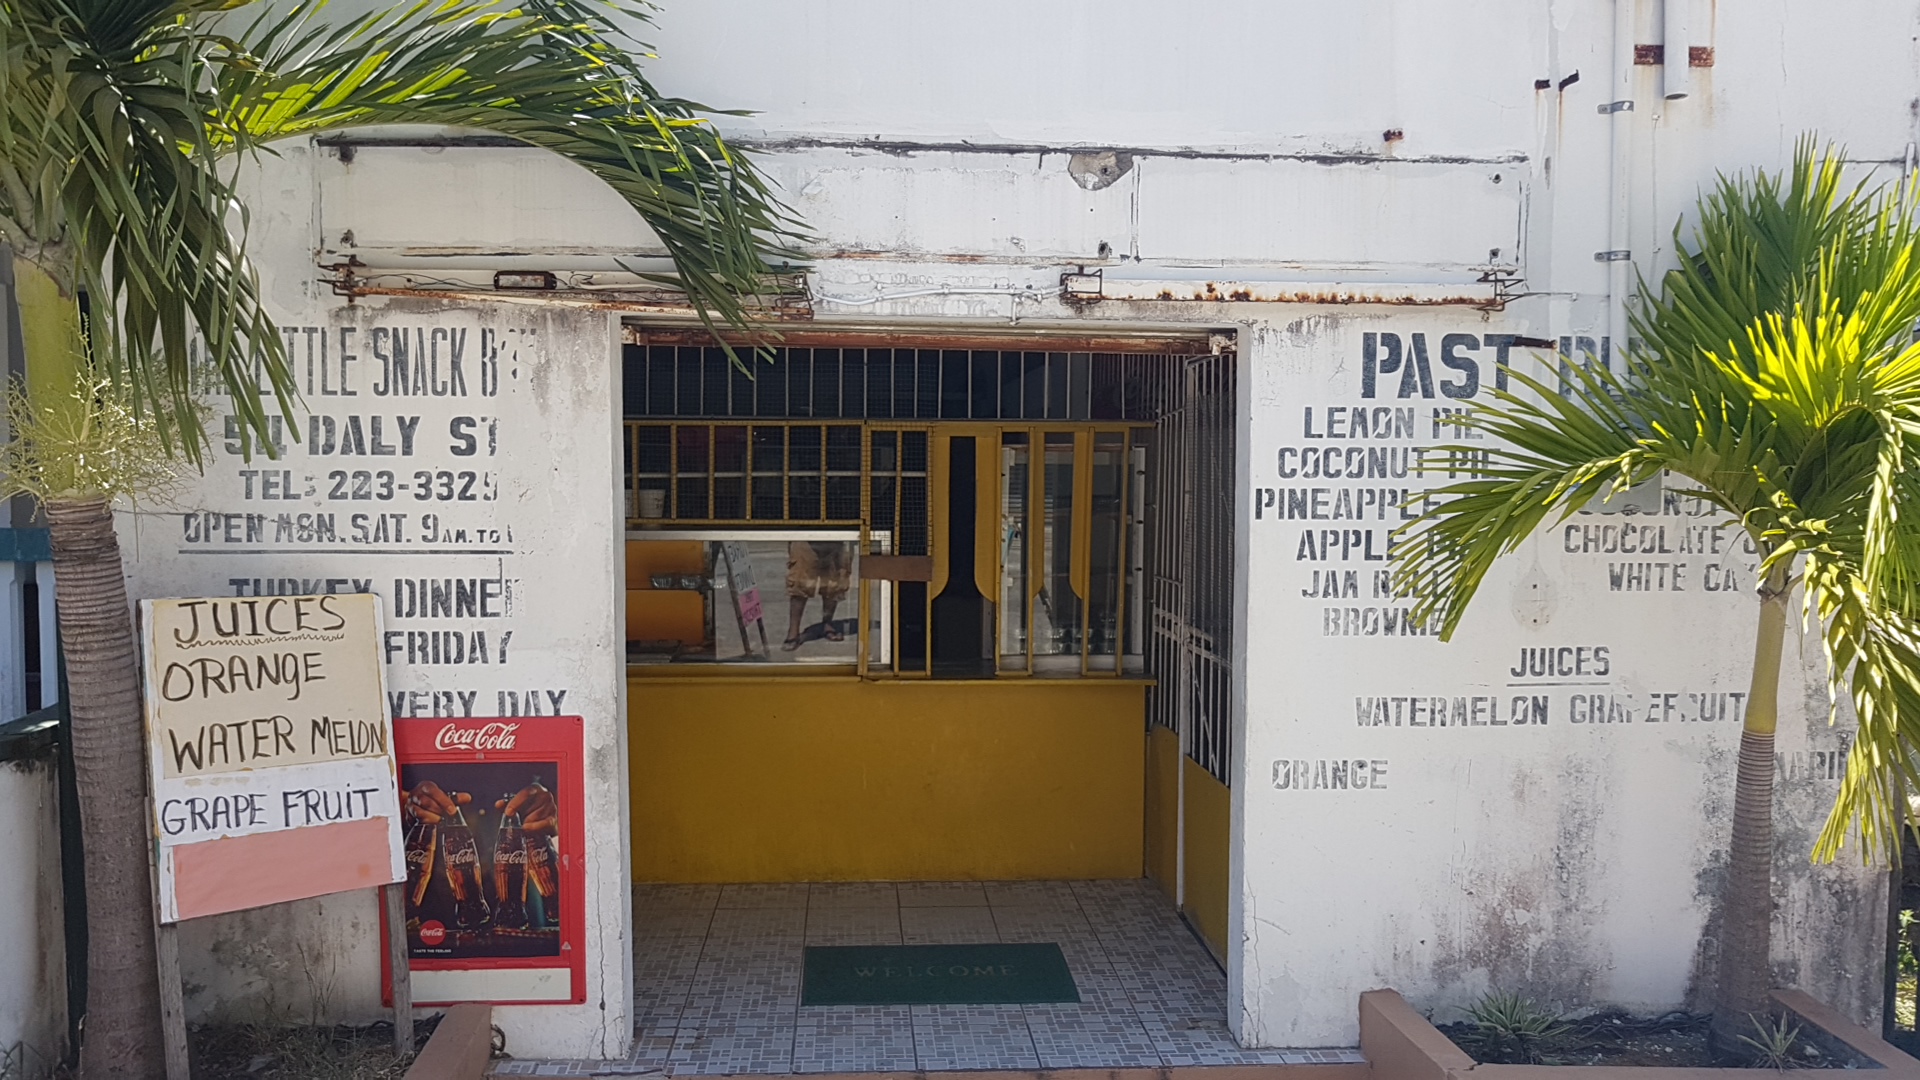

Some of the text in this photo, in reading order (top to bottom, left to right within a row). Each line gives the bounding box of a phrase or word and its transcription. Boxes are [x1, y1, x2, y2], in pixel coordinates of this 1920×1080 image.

[254, 326, 358, 396] LTTLE
[372, 327, 468, 397] SNACK
[308, 415, 421, 457] DALY
[1304, 407, 1484, 439] LEMON PIE
[1278, 447, 1430, 479] COCONUT
[1255, 488, 1441, 521] PINEAPPLE
[183, 513, 265, 544] OPEN
[1296, 529, 1406, 561] APPLE
[1302, 570, 1359, 599] JAM
[1608, 562, 1687, 592] WHITE
[174, 595, 346, 644] JUICES
[384, 631, 514, 665] FRIDAY
[1510, 645, 1611, 677] JUICES
[498, 690, 567, 718] DAY
[1355, 695, 1549, 727] WATERMELON
[168, 714, 385, 774] WATER MELON
[435, 722, 522, 751] Coca-Cola
[1271, 759, 1389, 790] ORANGE
[161, 793, 268, 836] GRAPE
[854, 964, 1020, 978] WELCOME
